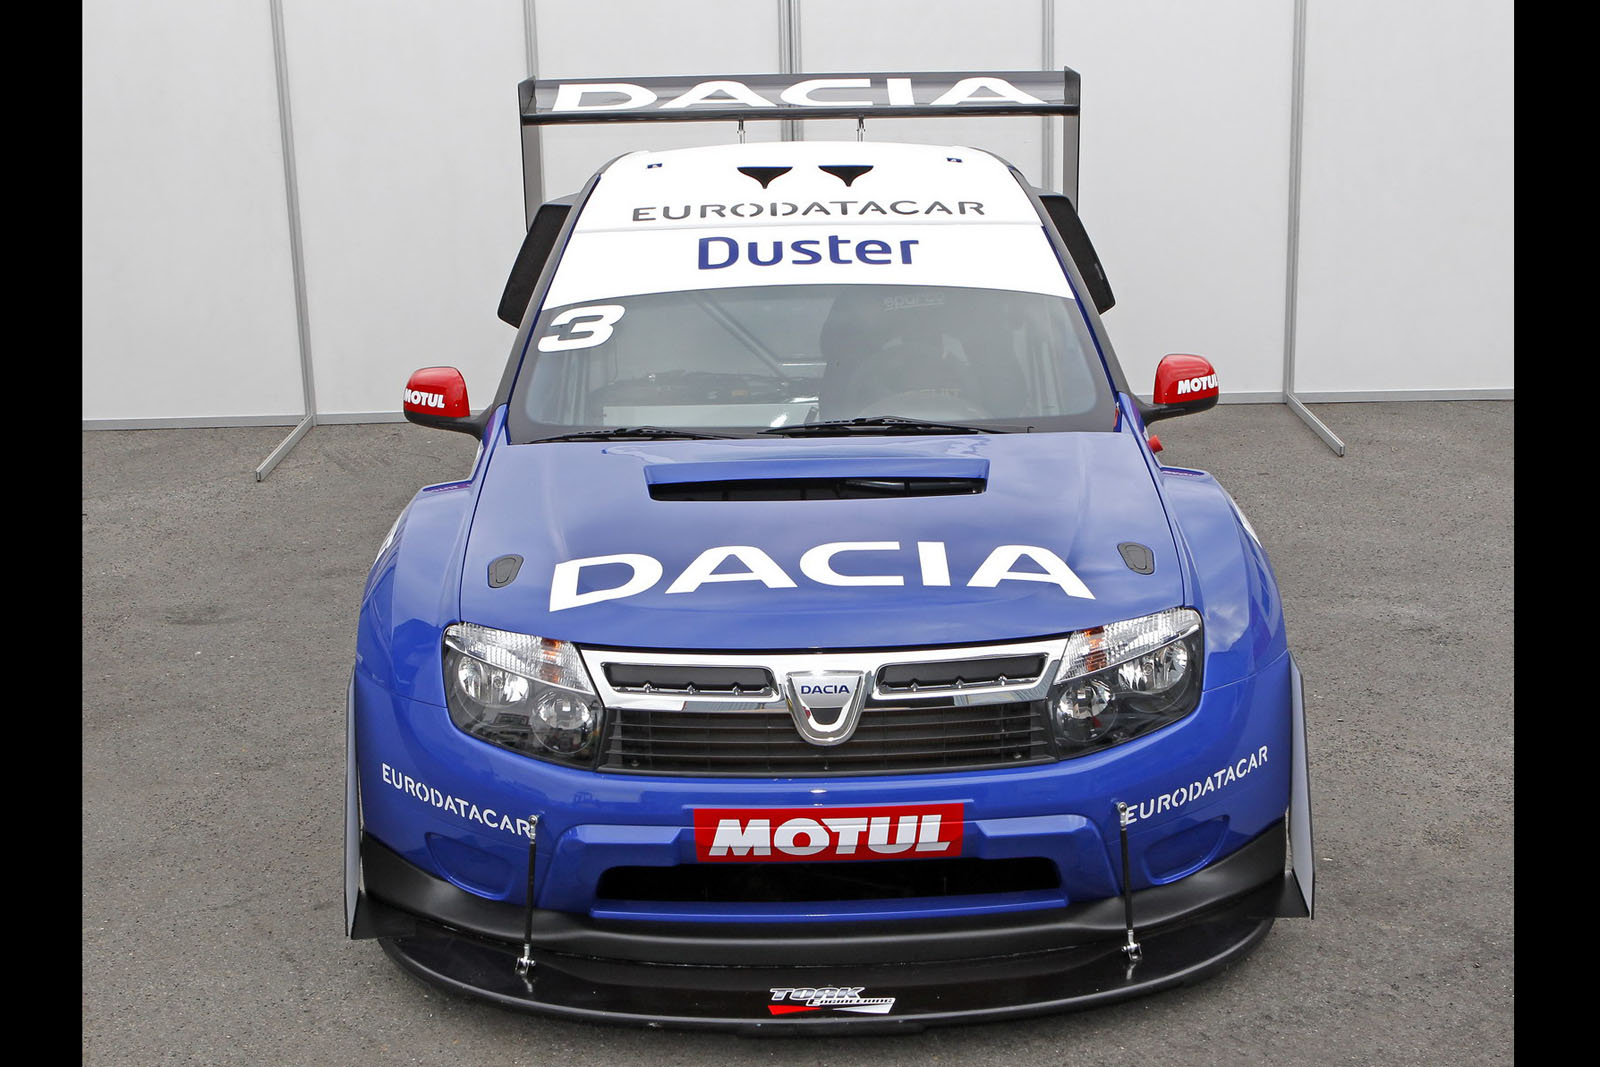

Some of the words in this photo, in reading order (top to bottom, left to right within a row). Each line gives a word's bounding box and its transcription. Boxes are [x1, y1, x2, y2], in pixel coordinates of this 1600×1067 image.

[550, 76, 1047, 111] DACIA
[633, 200, 985, 222] EURODATACAR
[698, 235, 920, 270] Duster
[538, 304, 625, 352] 3
[550, 541, 1096, 612] DACIA
[800, 684, 850, 695] DACIA
[381, 762, 532, 839] EURODATACAR
[1125, 745, 1269, 825] EURODATACAR
[709, 814, 950, 856] MOTUL
